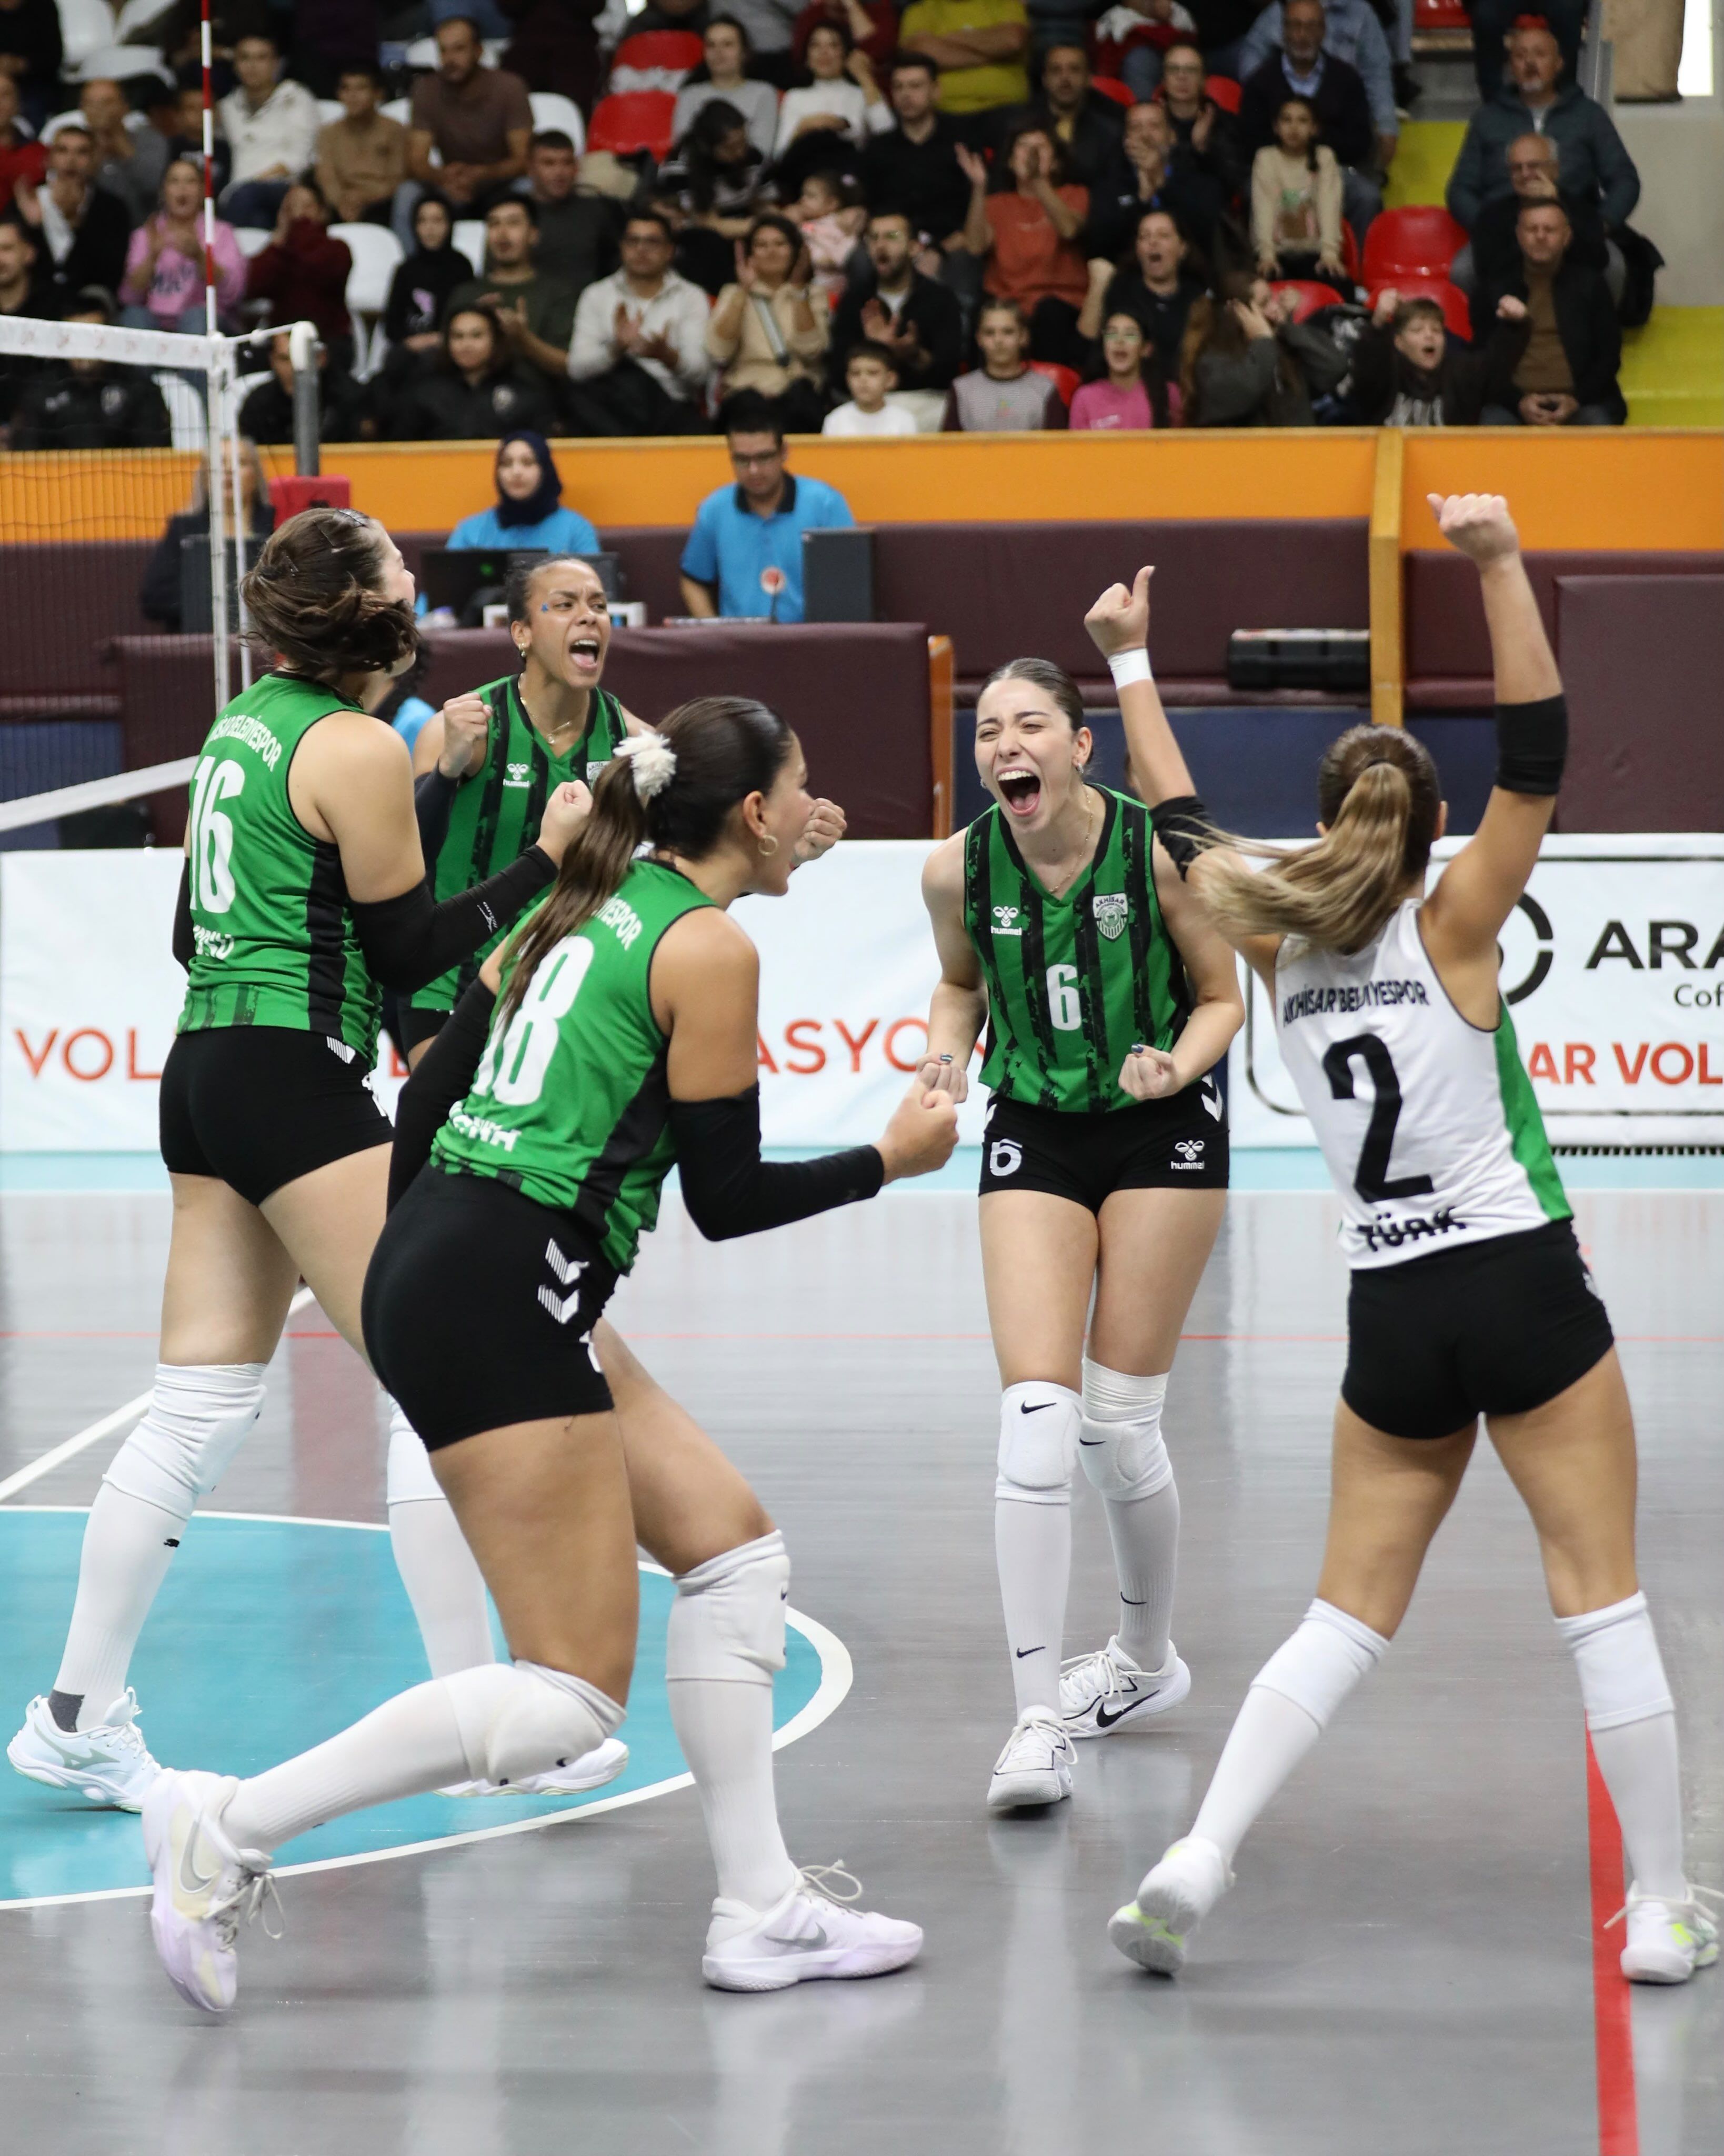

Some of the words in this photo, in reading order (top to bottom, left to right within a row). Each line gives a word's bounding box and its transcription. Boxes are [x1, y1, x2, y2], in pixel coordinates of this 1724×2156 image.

[503, 778, 529, 788] hummel
[189, 755, 245, 913] 16
[990, 925, 1023, 936] hummel
[1046, 964, 1082, 1031] 6
[14, 1026, 177, 1080] VOL
[1321, 1033, 1434, 1203] 2
[1171, 1161, 1205, 1170] hummel
[1357, 1206, 1467, 1252] TÜRK
